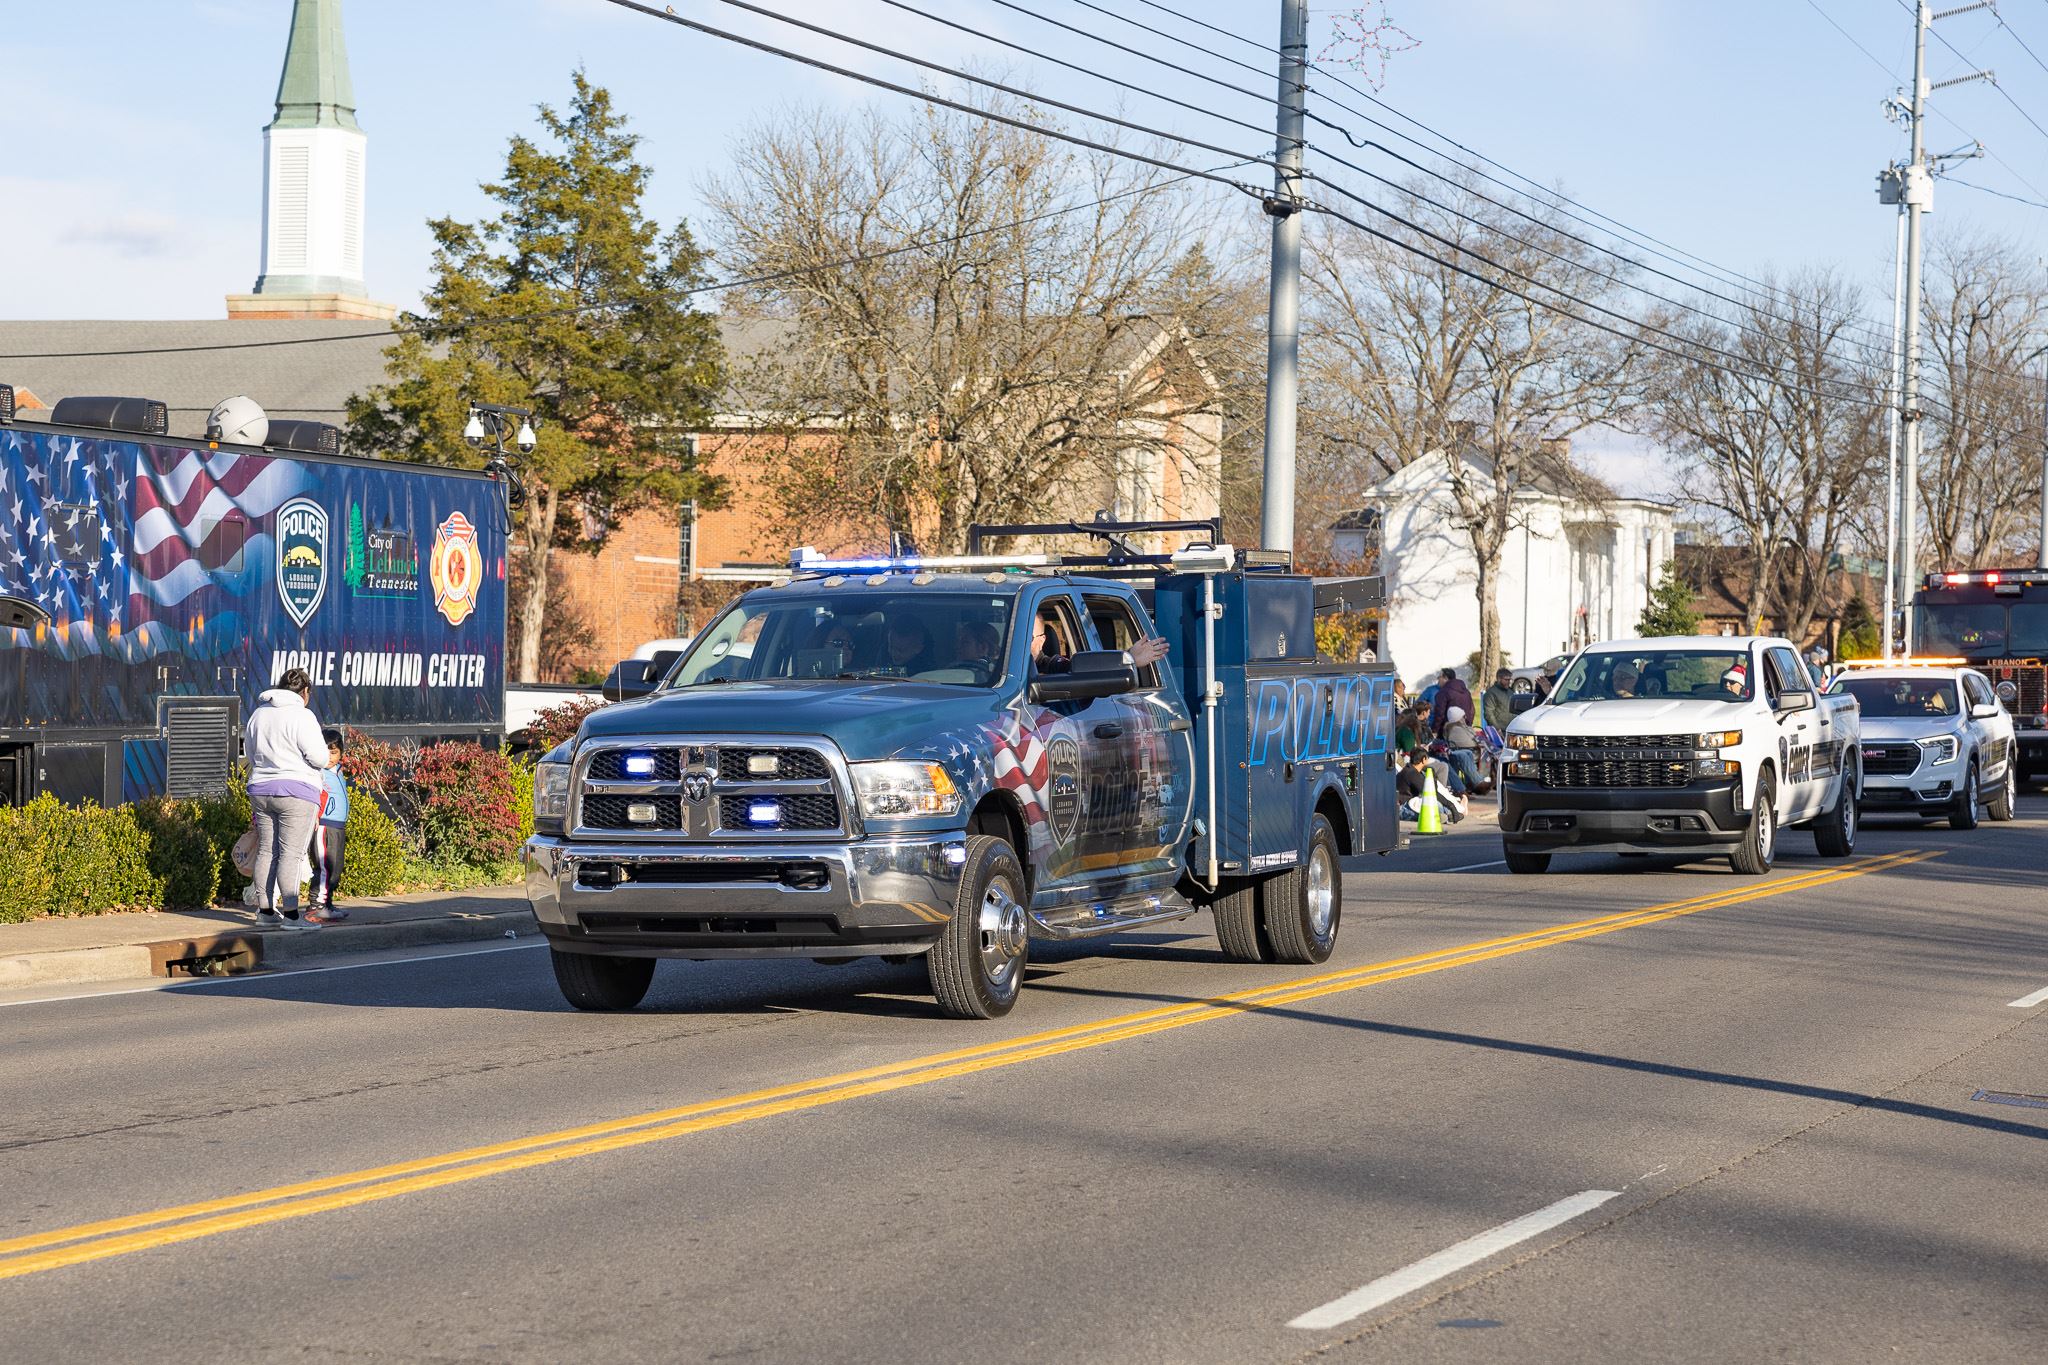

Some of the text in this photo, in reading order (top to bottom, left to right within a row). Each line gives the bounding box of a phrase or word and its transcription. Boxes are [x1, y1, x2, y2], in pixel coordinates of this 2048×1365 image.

[282, 511, 323, 545] POLICE
[368, 534, 393, 552] City of
[368, 549, 418, 575] Lebanon
[367, 574, 418, 591] Tennessee
[340, 651, 423, 688] COMMAND
[427, 653, 486, 688] CENTER
[1987, 658, 2028, 667] LEBANON
[1249, 675, 1395, 767] POLICE
[1051, 742, 1077, 774] POLICE
[1539, 750, 1687, 761] CHEVROLET
[1861, 749, 1886, 759] MC
[1084, 768, 1150, 835] POLICE
